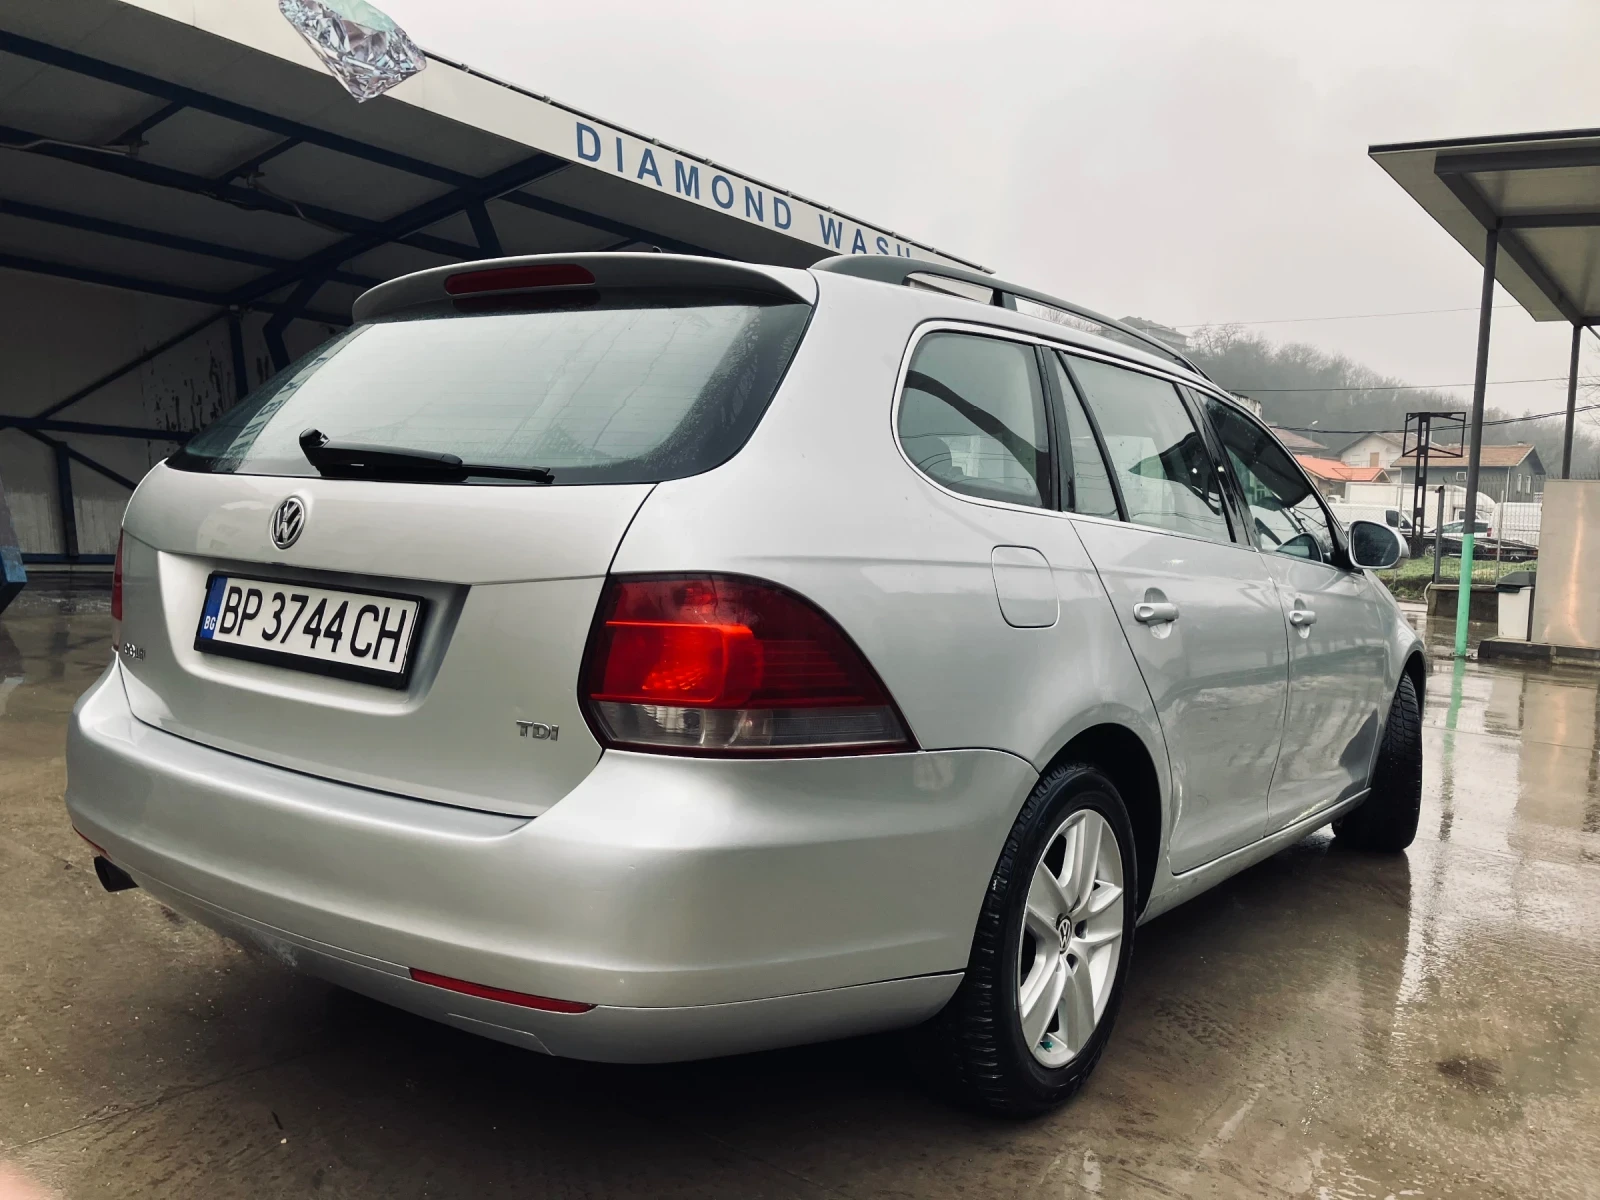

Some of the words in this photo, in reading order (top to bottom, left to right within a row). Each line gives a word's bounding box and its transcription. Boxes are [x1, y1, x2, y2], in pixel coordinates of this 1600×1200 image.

[576, 122, 792, 230] DIAMOND
[204, 615, 216, 630] BG
[516, 719, 559, 741] TDI
